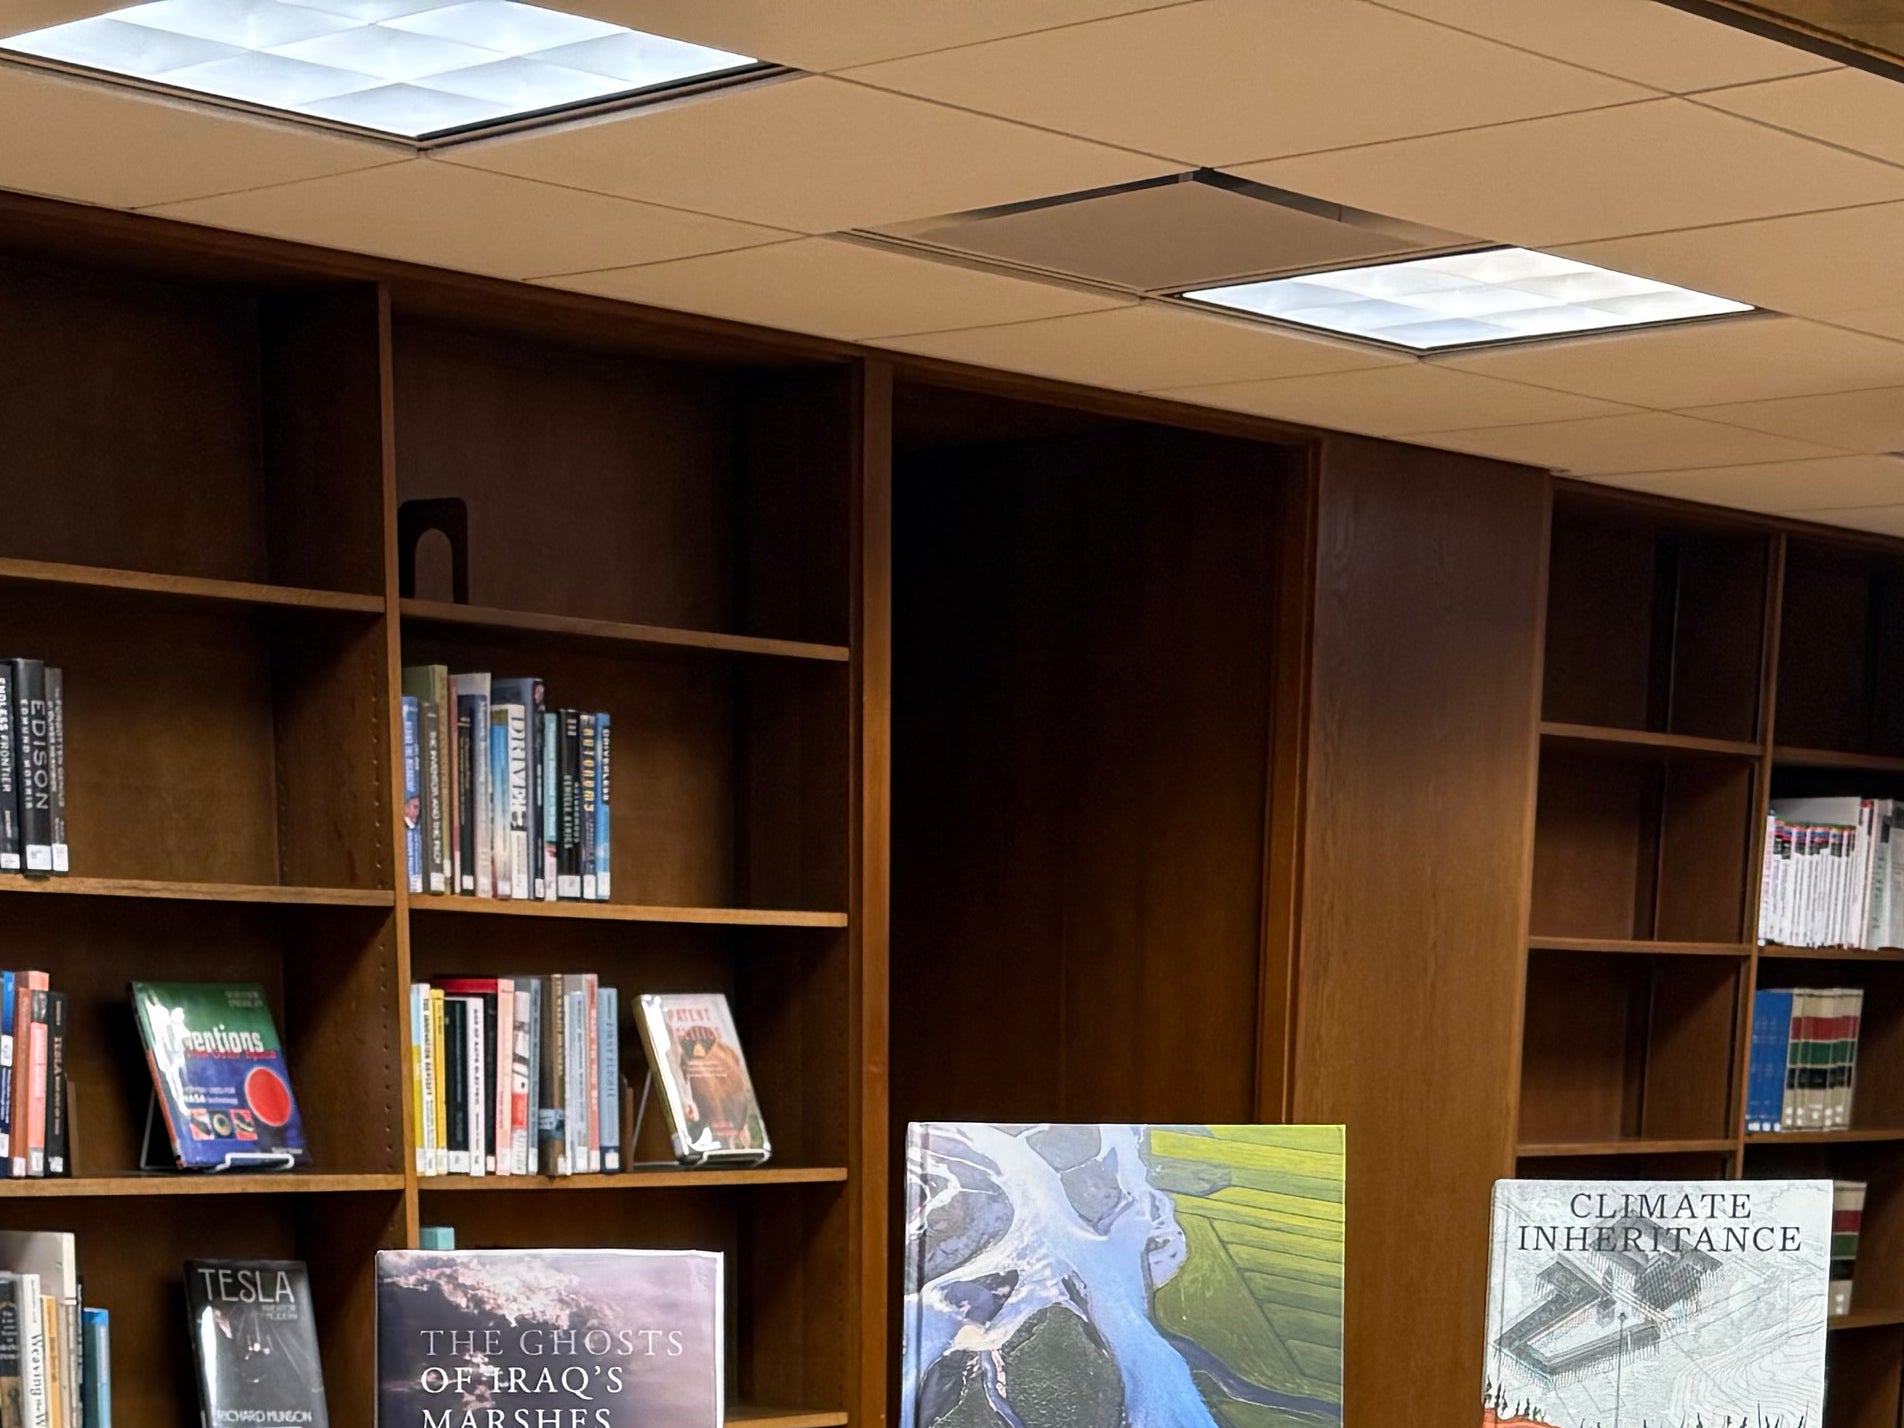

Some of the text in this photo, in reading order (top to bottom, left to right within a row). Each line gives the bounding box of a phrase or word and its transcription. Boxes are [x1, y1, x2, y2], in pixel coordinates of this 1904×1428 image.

[1570, 1193, 1752, 1219] CLIMATE
[1517, 1225, 1802, 1252] INHERITANCE
[198, 1267, 296, 1305] TESLA
[420, 1328, 684, 1357] THE GHOSTS
[420, 1366, 484, 1394] OF
